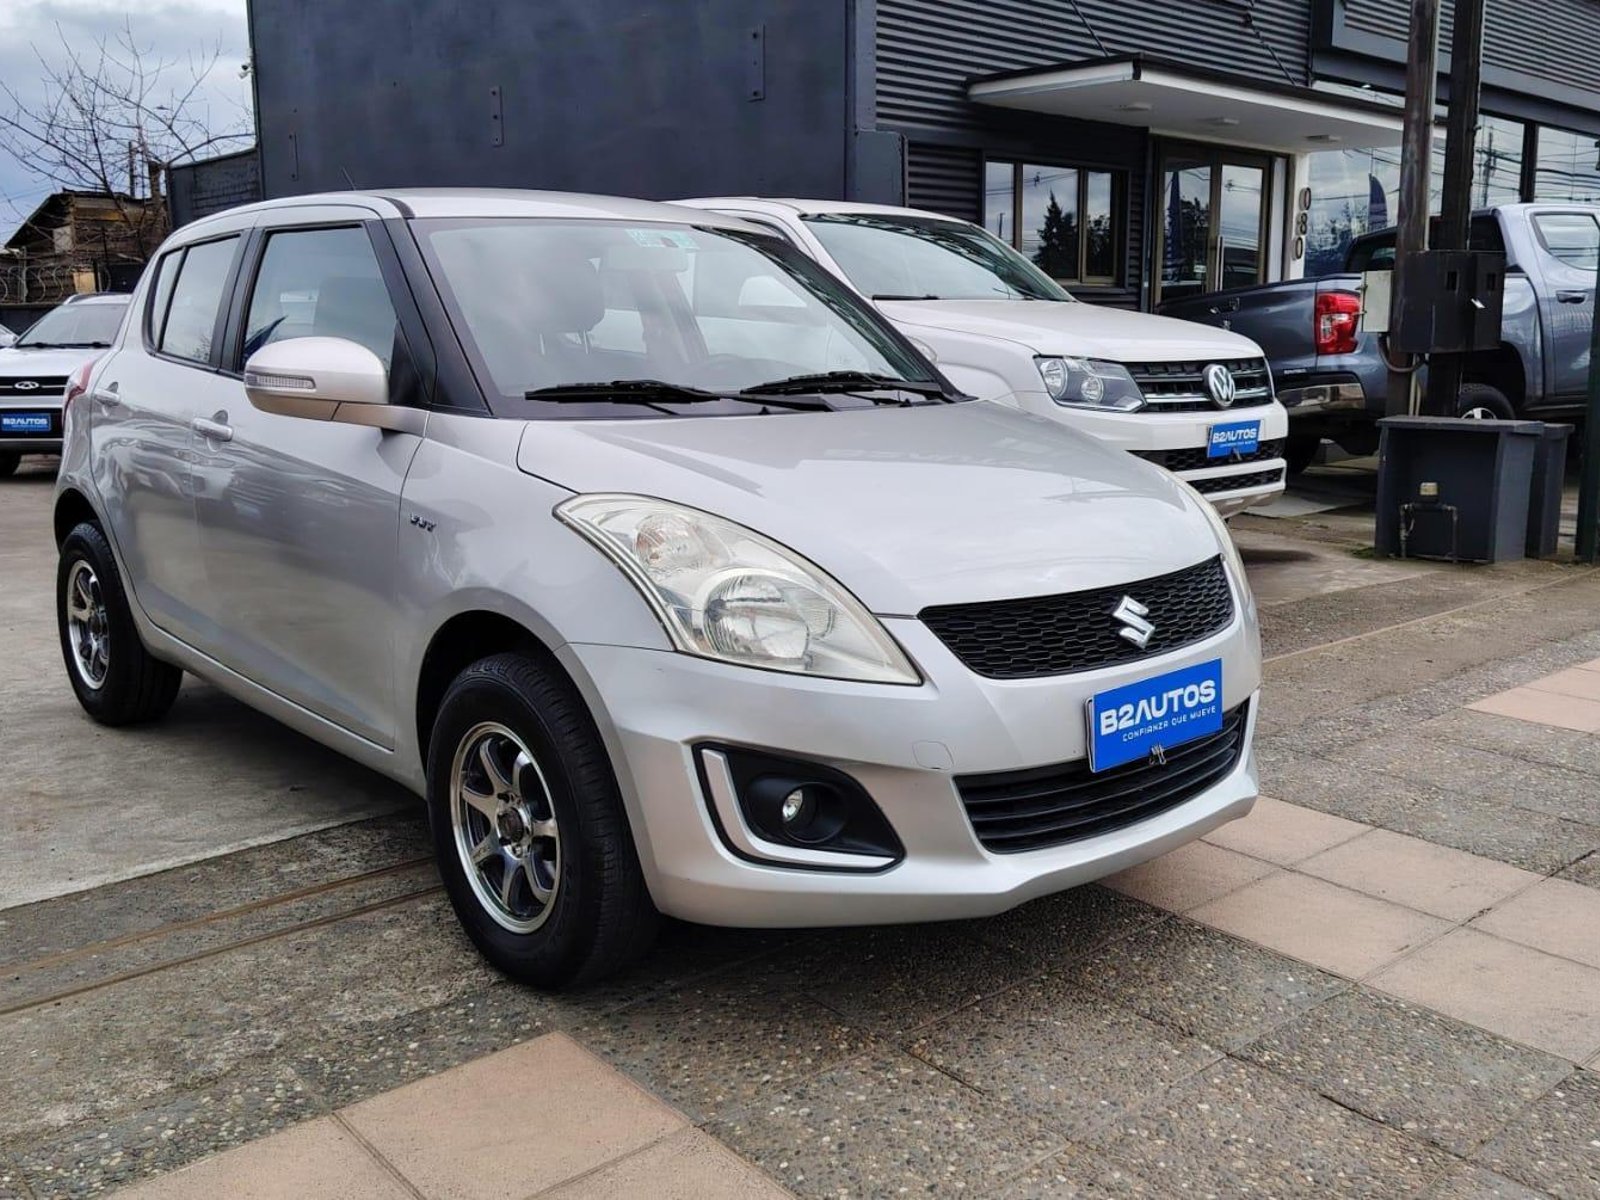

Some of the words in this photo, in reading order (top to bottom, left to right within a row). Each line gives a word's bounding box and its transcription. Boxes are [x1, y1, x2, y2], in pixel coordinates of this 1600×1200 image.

[1212, 428, 1257, 443] B2AUTOS
[1100, 680, 1216, 736] B2AUTOS
[1171, 714, 1187, 726] QUE
[1189, 705, 1216, 719] MUEVE
